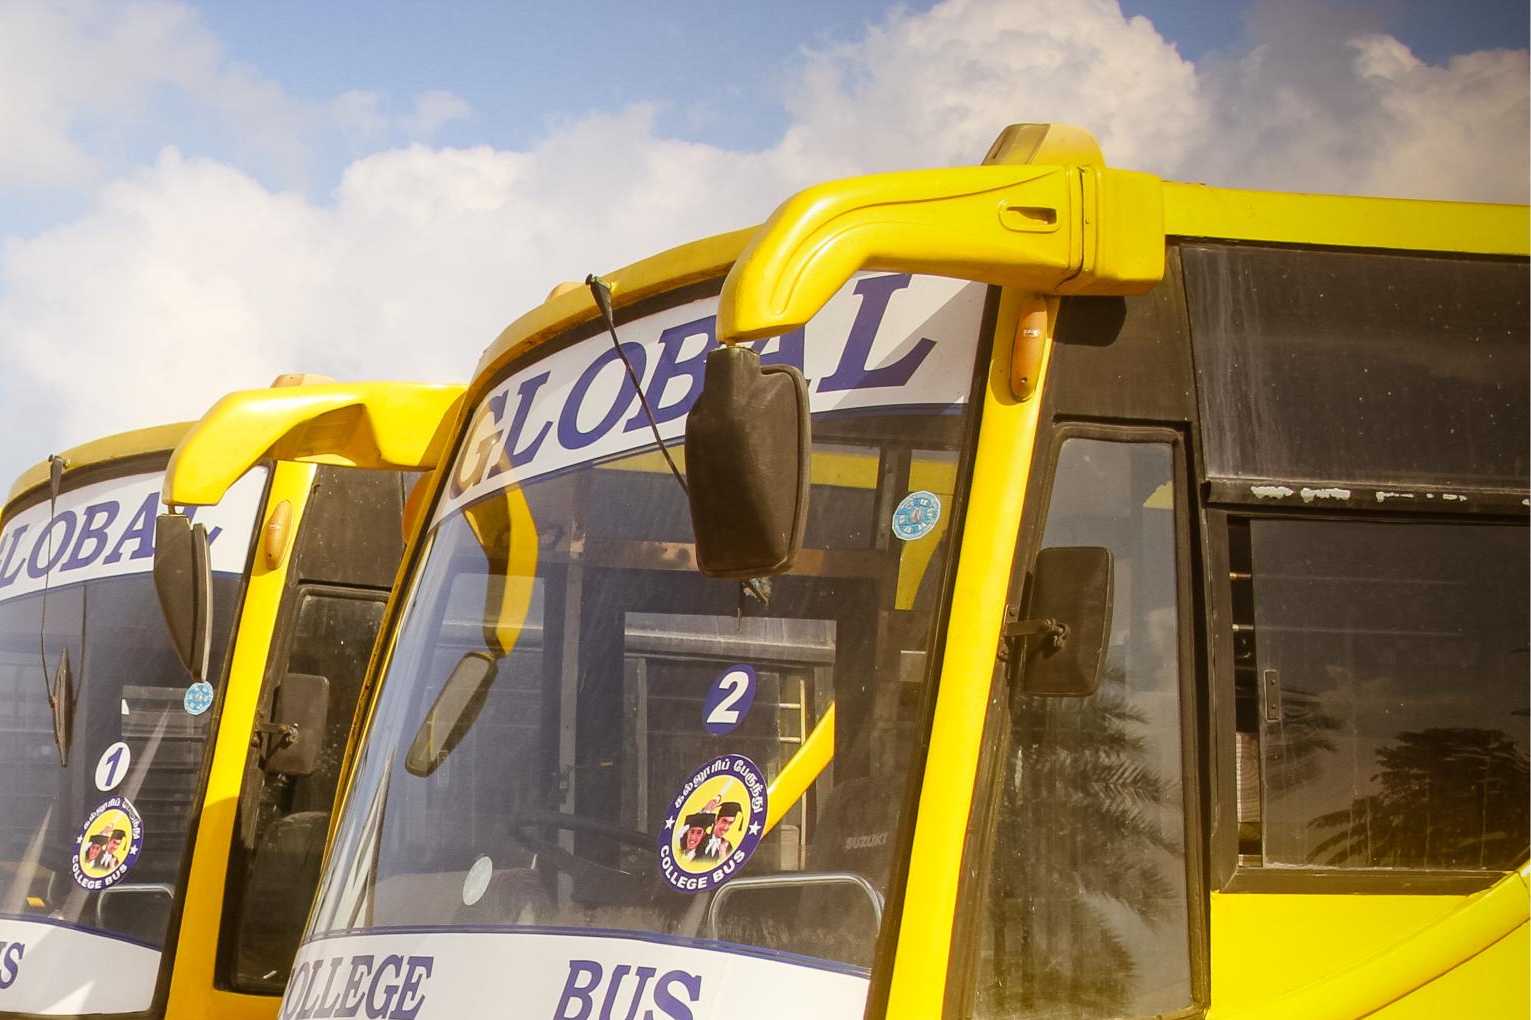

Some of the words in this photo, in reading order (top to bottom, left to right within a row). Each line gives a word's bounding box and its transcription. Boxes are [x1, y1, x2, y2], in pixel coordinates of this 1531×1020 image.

[706, 671, 749, 724] 2
[105, 746, 122, 787] 1
[845, 832, 888, 850] SUZUKI
[72, 854, 102, 890] COLLEGE
[105, 863, 128, 886] BUS
[660, 844, 708, 890] COLLEGE
[712, 849, 746, 883] BUS
